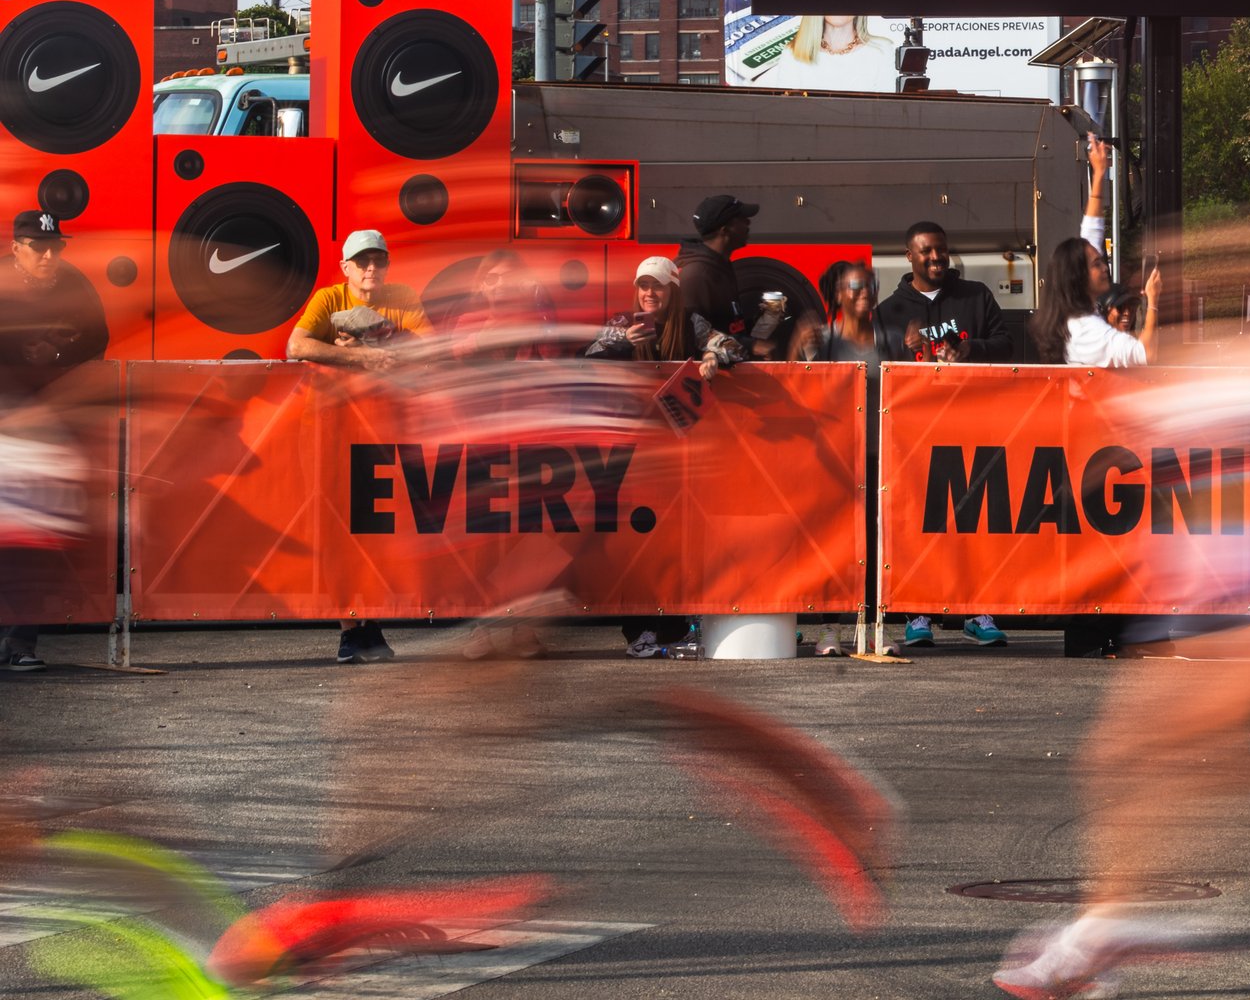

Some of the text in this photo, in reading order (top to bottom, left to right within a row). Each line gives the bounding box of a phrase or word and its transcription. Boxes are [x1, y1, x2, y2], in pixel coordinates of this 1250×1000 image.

[922, 22, 1000, 32] EPORTACIONES
[1002, 22, 1045, 31] PREVIAS
[928, 46, 1032, 61] gadaAngel.com
[349, 443, 657, 535] EVERY.
